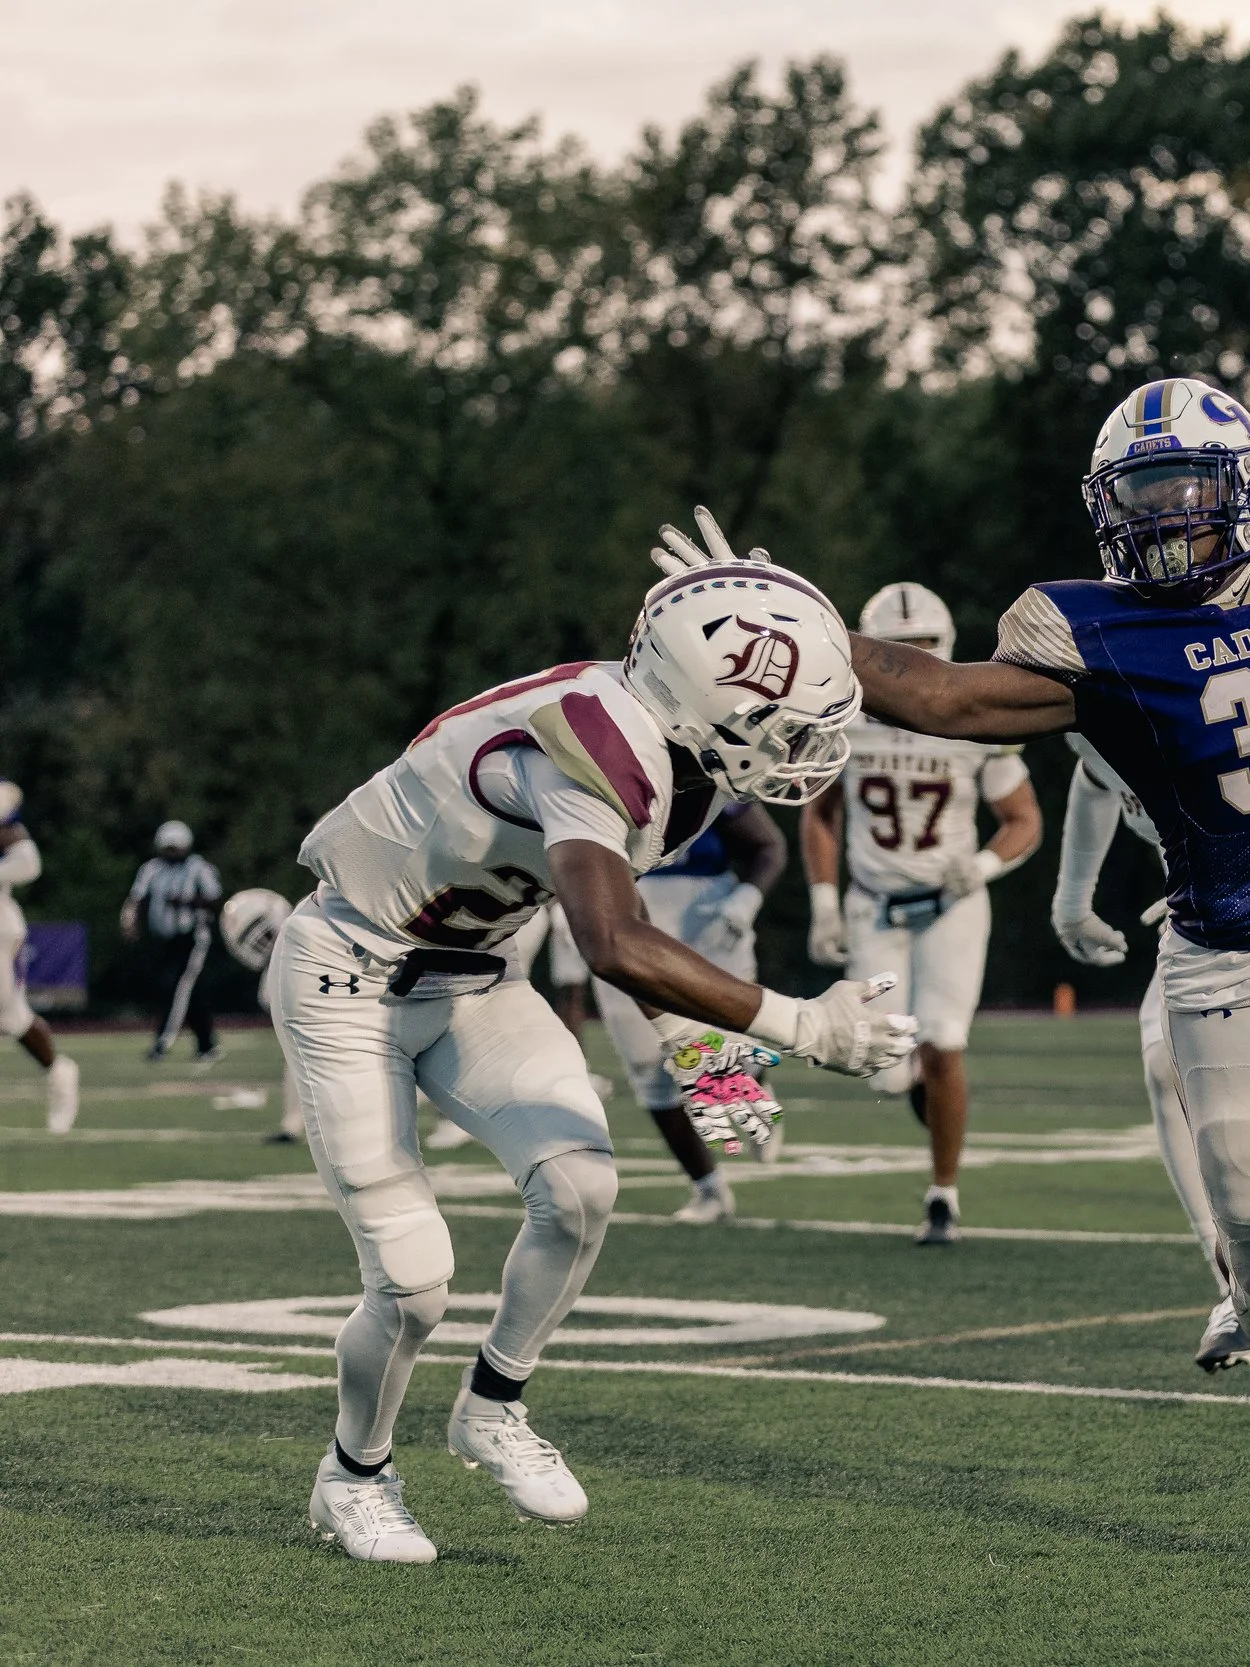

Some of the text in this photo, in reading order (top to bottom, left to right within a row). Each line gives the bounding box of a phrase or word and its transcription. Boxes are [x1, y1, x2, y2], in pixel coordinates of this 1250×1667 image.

[1134, 438, 1172, 454] CADETS
[715, 614, 799, 701] D
[859, 774, 953, 852] 97
